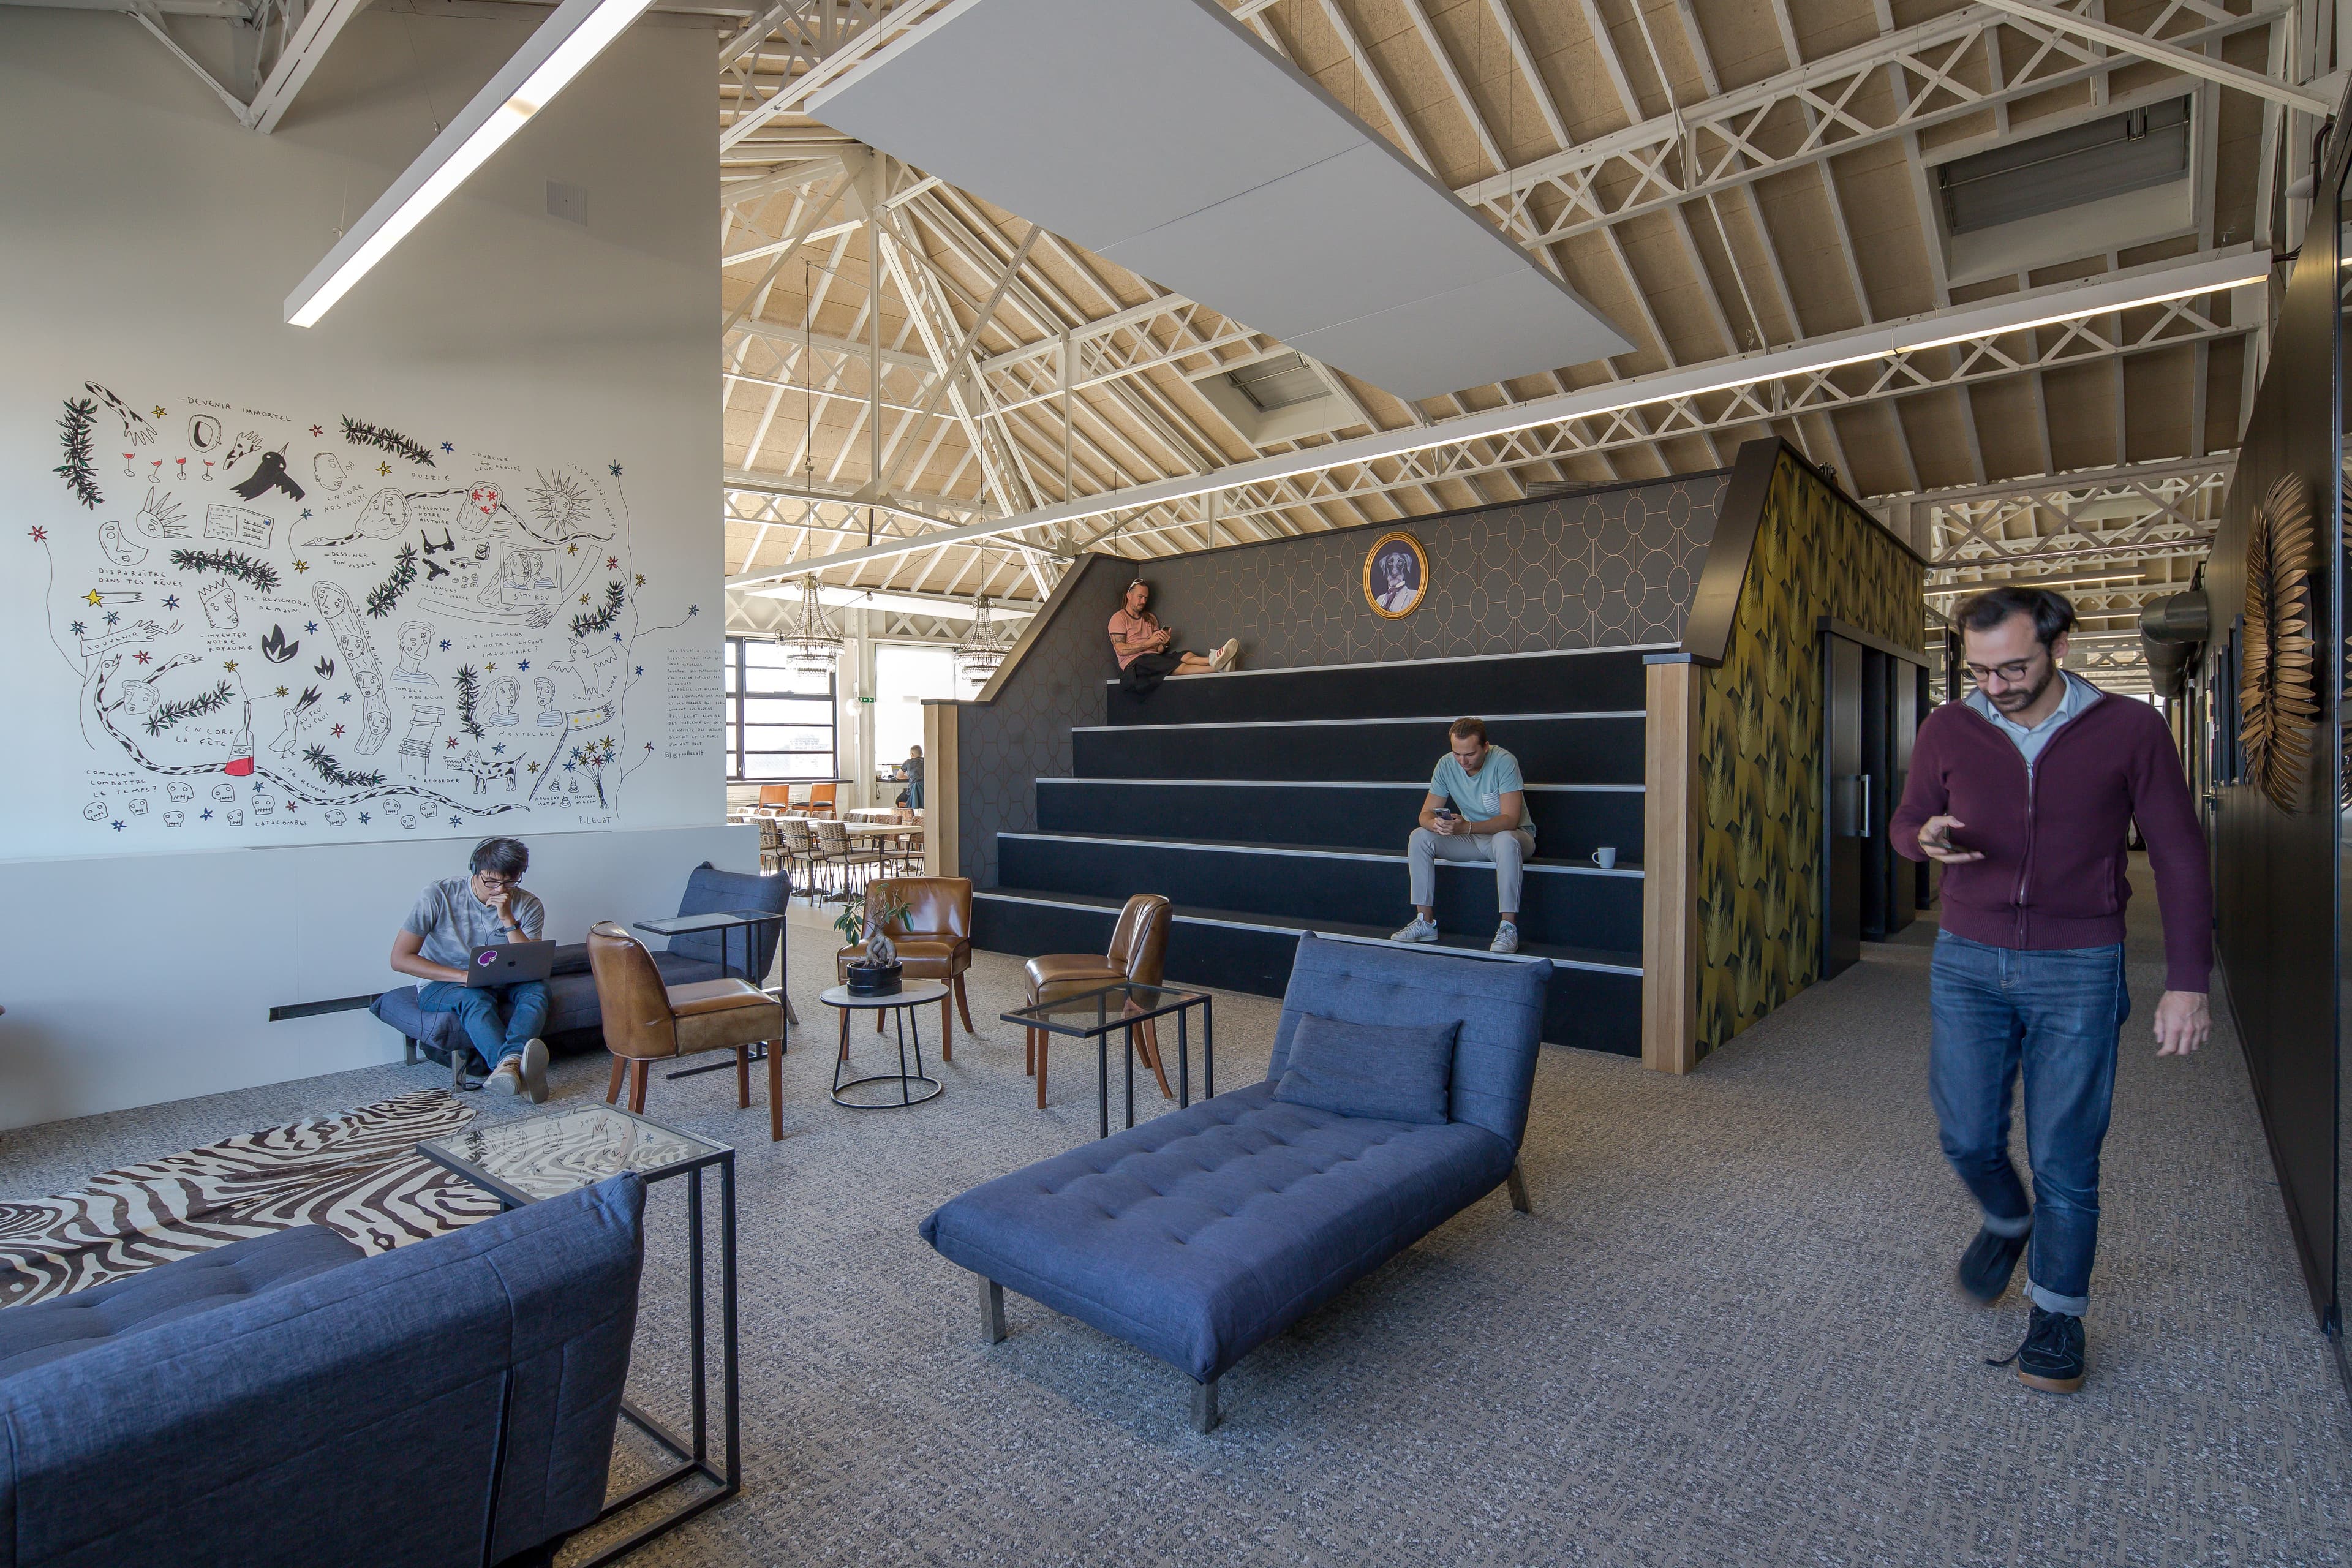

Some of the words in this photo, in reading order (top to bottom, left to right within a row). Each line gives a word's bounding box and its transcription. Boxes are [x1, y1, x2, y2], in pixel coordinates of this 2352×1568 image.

[187, 396, 232, 409] DEVENIR
[243, 408, 292, 421] IMMORTEL
[412, 472, 450, 481] PUZZLE
[324, 504, 341, 513] NOS
[346, 494, 368, 508] NUITS
[153, 578, 183, 587] RÊVES
[262, 597, 310, 608] REVIENDRAI
[87, 631, 138, 651] SOUVENIR
[355, 604, 367, 625] TRAIN
[365, 630, 372, 639] DE
[371, 646, 383, 665] NUIT
[606, 675, 617, 693] LUNE
[200, 737, 226, 747] FÊTE
[287, 767, 296, 777] TE
[300, 778, 326, 794] REVOIR
